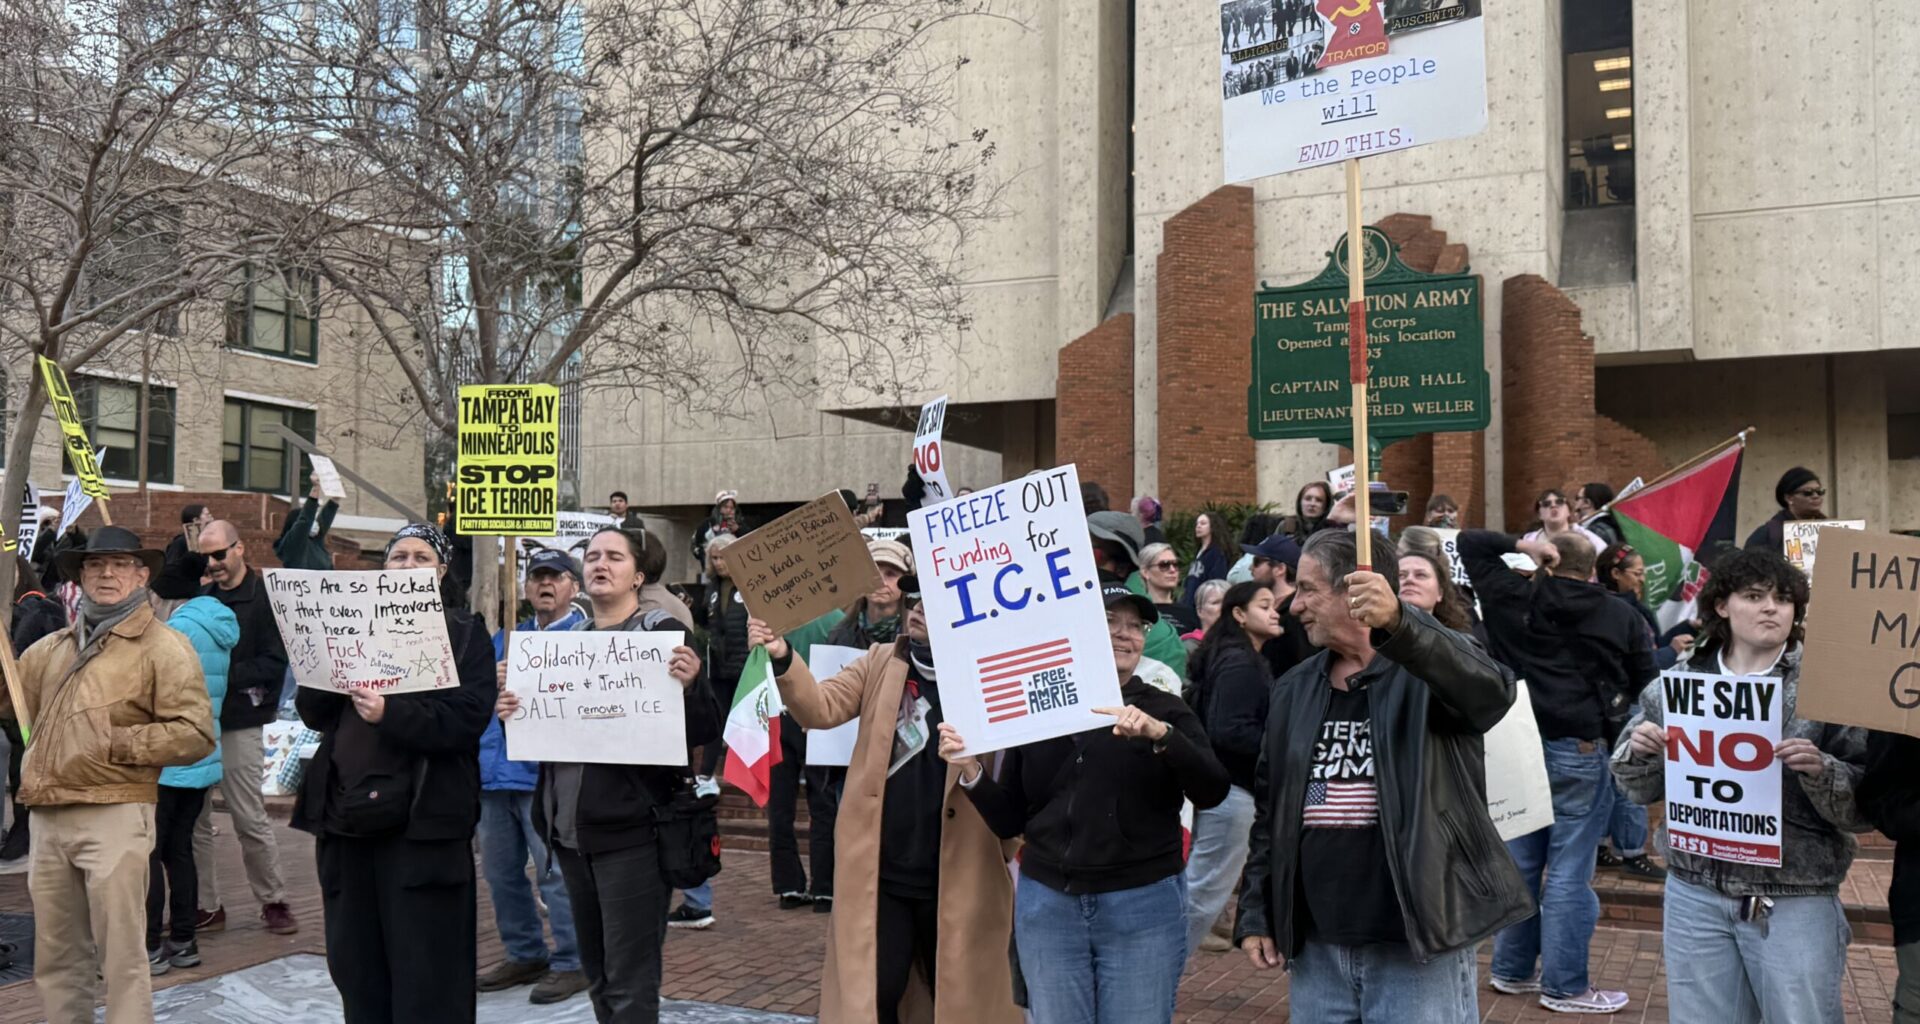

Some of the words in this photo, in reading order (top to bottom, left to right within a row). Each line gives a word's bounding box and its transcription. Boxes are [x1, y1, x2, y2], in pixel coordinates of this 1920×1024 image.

[1393, 5, 1464, 29] AUSCHWITZ
[1230, 39, 1289, 62] ALLIGATOR
[1327, 41, 1386, 63] TRAITOR
[1261, 89, 1286, 106] We
[1301, 76, 1339, 98] the
[1350, 58, 1437, 87] People
[1322, 94, 1377, 120] will
[1298, 140, 1339, 163] END
[1345, 128, 1413, 154] THIS.
[1259, 302, 1296, 319] THE
[1302, 292, 1407, 316] SALVTION
[1414, 288, 1473, 307] ARMY
[1313, 321, 1351, 334] Tamp
[1372, 317, 1417, 330] Corps
[1277, 337, 1332, 352] Opened
[1398, 329, 1456, 343] location
[488, 389, 530, 398] FROM
[1270, 380, 1340, 395] CAPTAIN
[1368, 375, 1411, 390] LBUR
[1420, 373, 1466, 386] HALL
[461, 397, 519, 424] TAMPA
[523, 396, 555, 423] BAY
[916, 406, 931, 438] WE
[928, 400, 946, 434] SAY
[1367, 403, 1405, 417] FRED
[1412, 400, 1475, 414] WELLER
[499, 424, 520, 433] TO
[461, 432, 555, 456] MINNEAPOLIS
[914, 441, 940, 475] NO
[460, 465, 555, 484] STOP
[460, 488, 487, 514] ICE
[490, 488, 554, 514] TERROR
[925, 489, 1010, 543] FREEZE
[1022, 472, 1068, 513] OUT
[461, 520, 478, 530] PARTY
[489, 520, 515, 530] SOCIALISM
[522, 520, 552, 530] LIBERATION
[560, 520, 585, 530] RIGHTS
[763, 529, 802, 553] being
[932, 537, 1012, 576] Funding
[1026, 520, 1059, 552] for
[762, 569, 814, 604] dangerous
[818, 554, 840, 572] but
[1851, 551, 1920, 591] HAT
[267, 572, 311, 597] Things
[320, 578, 343, 594] Are
[350, 583, 368, 593] so
[376, 574, 436, 596] fucked
[944, 547, 1094, 629] I.C.E.
[273, 601, 288, 623] Up
[294, 601, 324, 619] that
[330, 607, 363, 619] even
[374, 599, 443, 619] Introverts
[295, 623, 312, 636] Are
[323, 621, 360, 636] here
[605, 636, 667, 665] Action.
[331, 668, 347, 680] US
[538, 673, 574, 693] Love
[577, 704, 625, 715] removes
[634, 700, 663, 713] ICE
[1663, 676, 1705, 717] WE
[1713, 681, 1775, 722] SAY
[1666, 725, 1774, 772] NO
[1686, 775, 1744, 804] TO
[1669, 801, 1777, 837] DEPORTATIONS
[1712, 842, 1739, 853] Freedom
[1739, 847, 1757, 856] Road
[1712, 850, 1737, 860] Socialist
[1737, 854, 1780, 865] Organization
